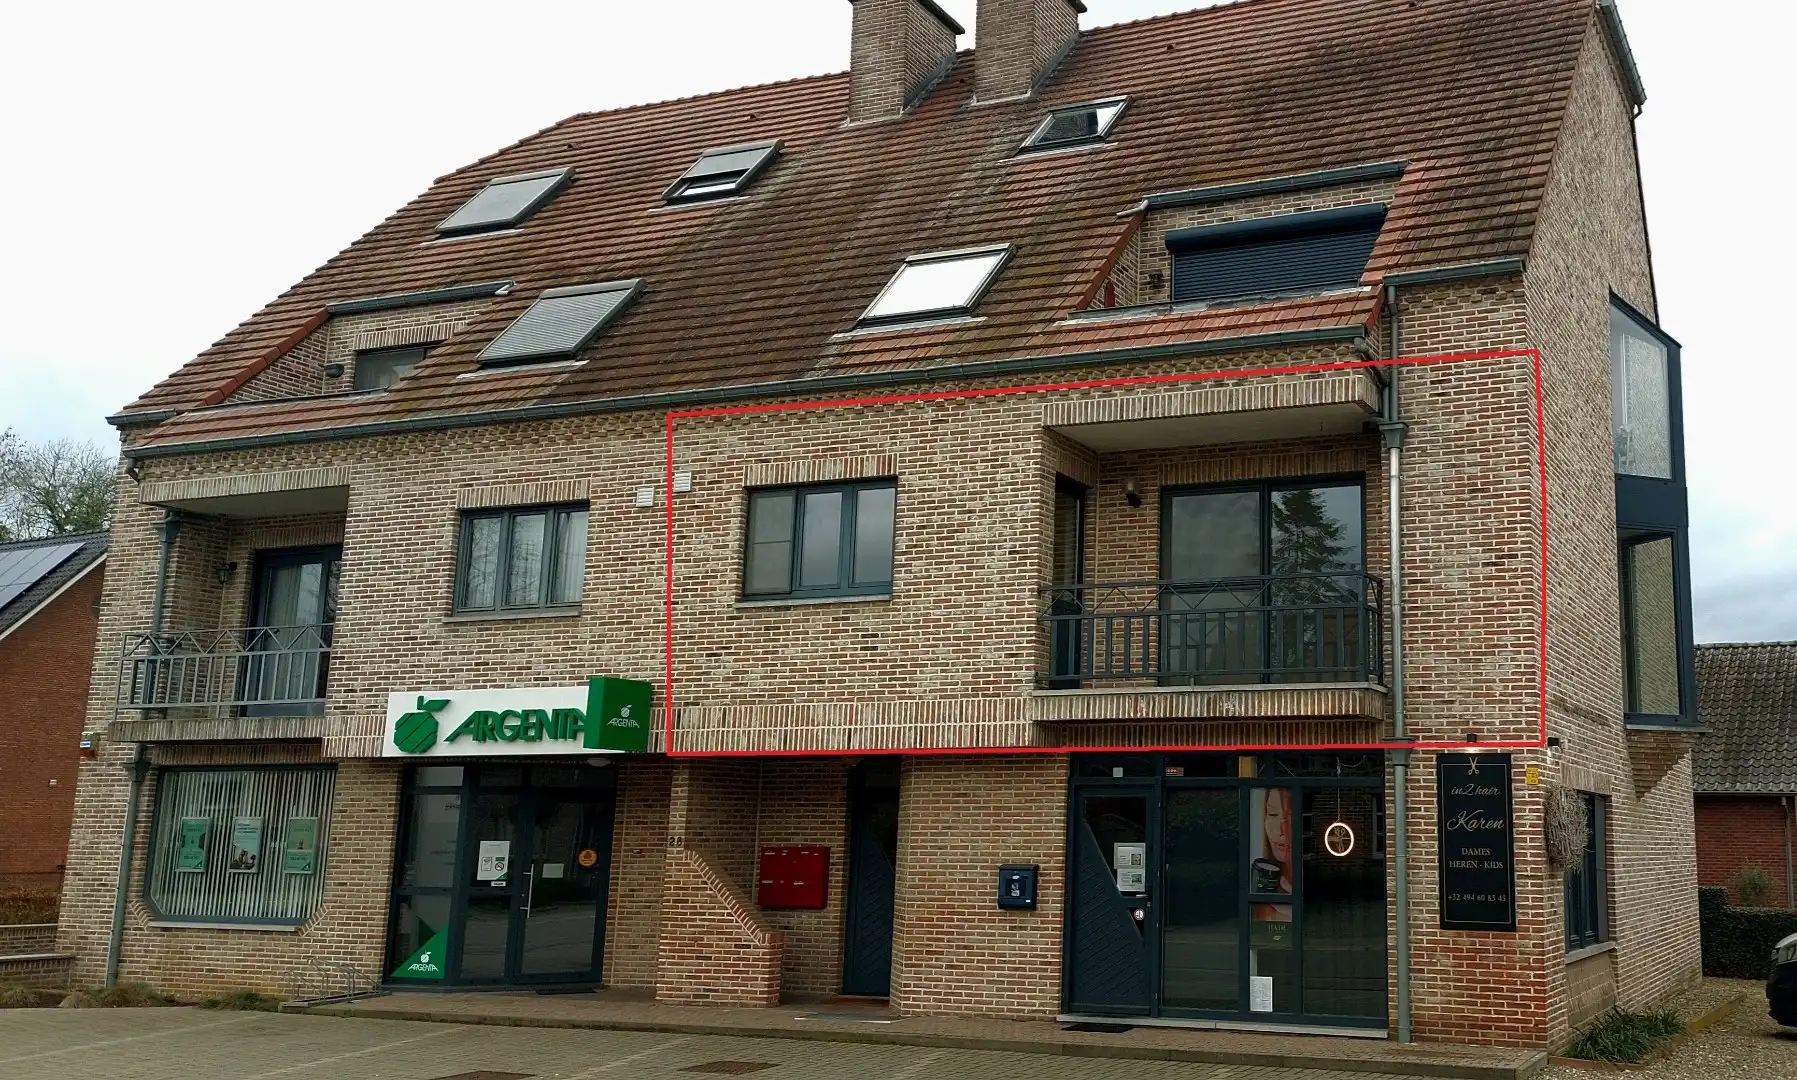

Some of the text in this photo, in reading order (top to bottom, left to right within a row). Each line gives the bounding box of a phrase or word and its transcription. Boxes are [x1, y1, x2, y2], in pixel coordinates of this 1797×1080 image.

[606, 717, 640, 729] ARGENTA
[1446, 809, 1505, 831] Karen
[1461, 847, 1491, 856] DAMES
[1449, 860, 1478, 869] HEREN
[1484, 860, 1504, 869] KIDS
[1447, 893, 1461, 901] +32
[407, 963, 439, 972] ARGENTA
